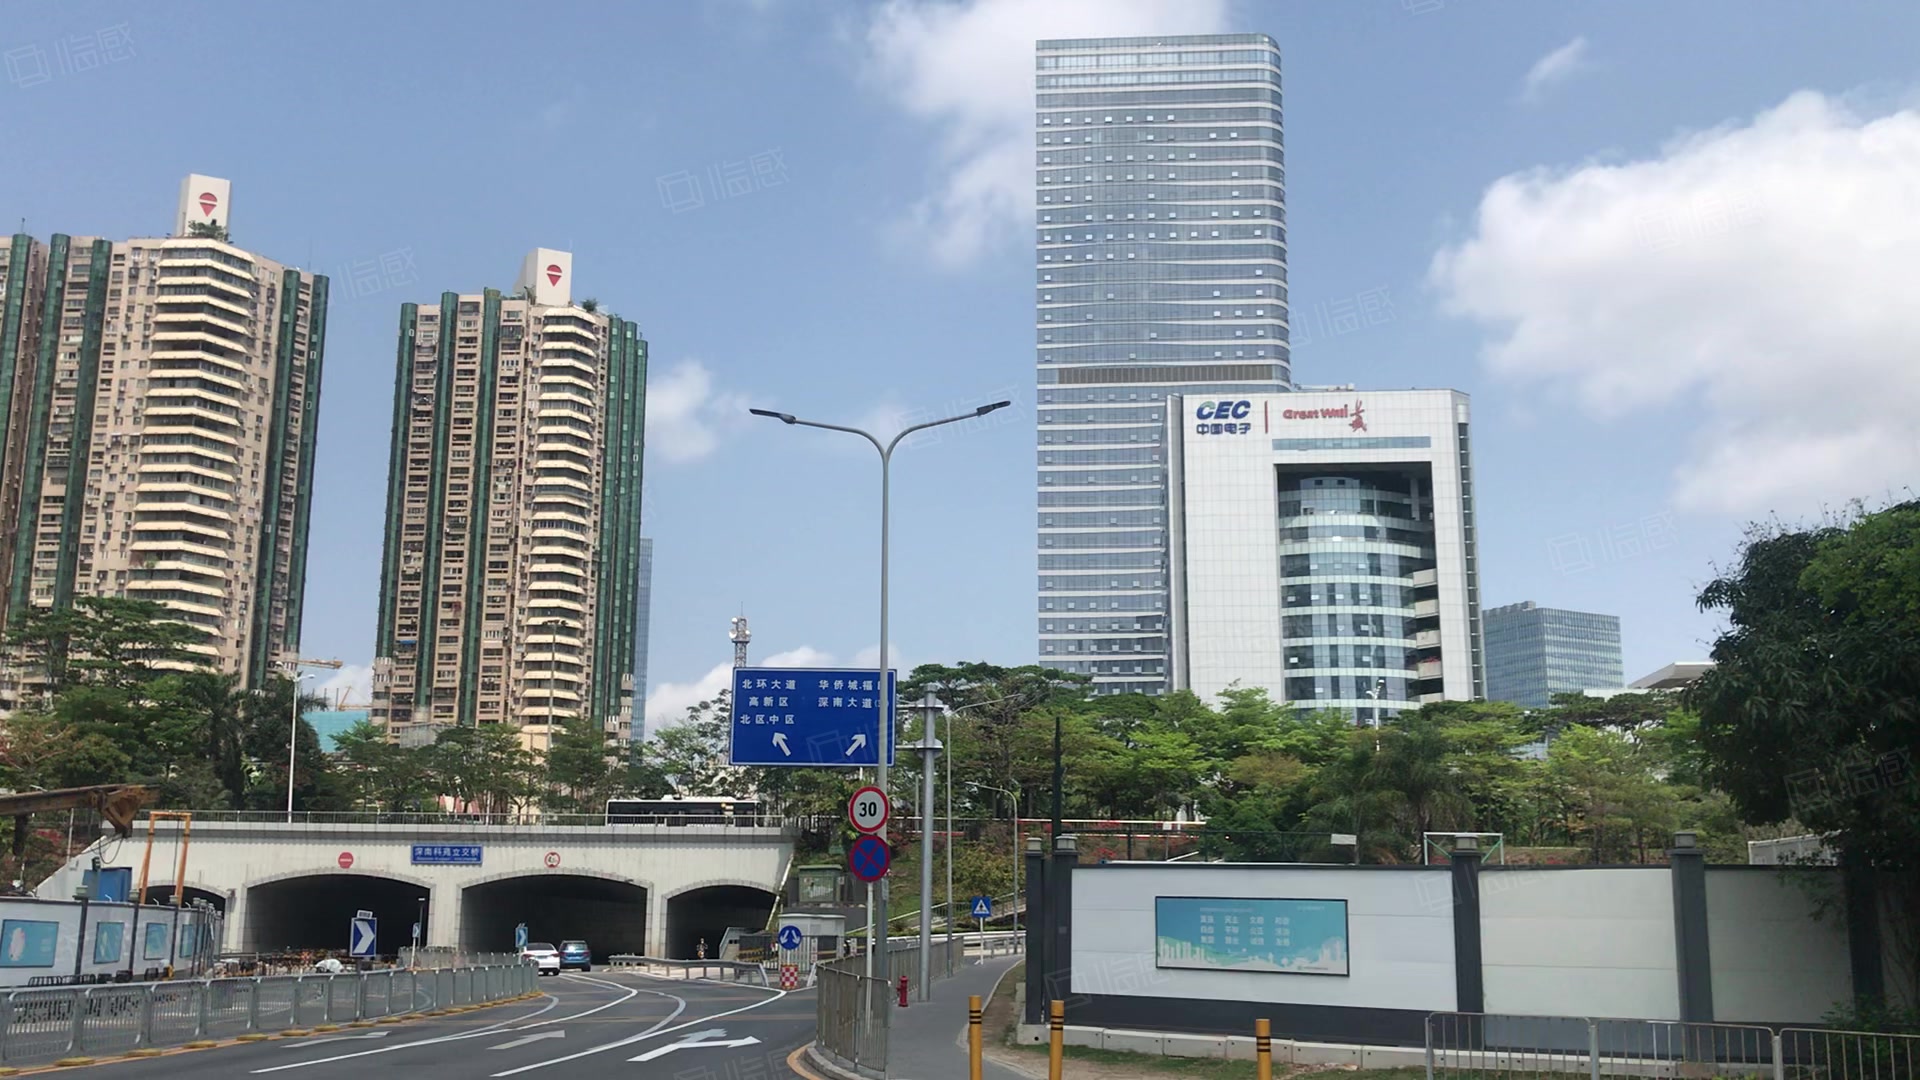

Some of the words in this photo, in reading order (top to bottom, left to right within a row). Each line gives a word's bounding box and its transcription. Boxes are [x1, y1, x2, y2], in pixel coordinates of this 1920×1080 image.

[1196, 400, 1251, 420] CEC
[1283, 409, 1320, 420] Great
[1321, 404, 1348, 418] Wall
[1196, 422, 1251, 435] 中国电子
[741, 679, 797, 691] 北环大道
[818, 679, 881, 691] 华侨城.福
[748, 696, 789, 707] 高新区
[859, 802, 877, 817] 30
